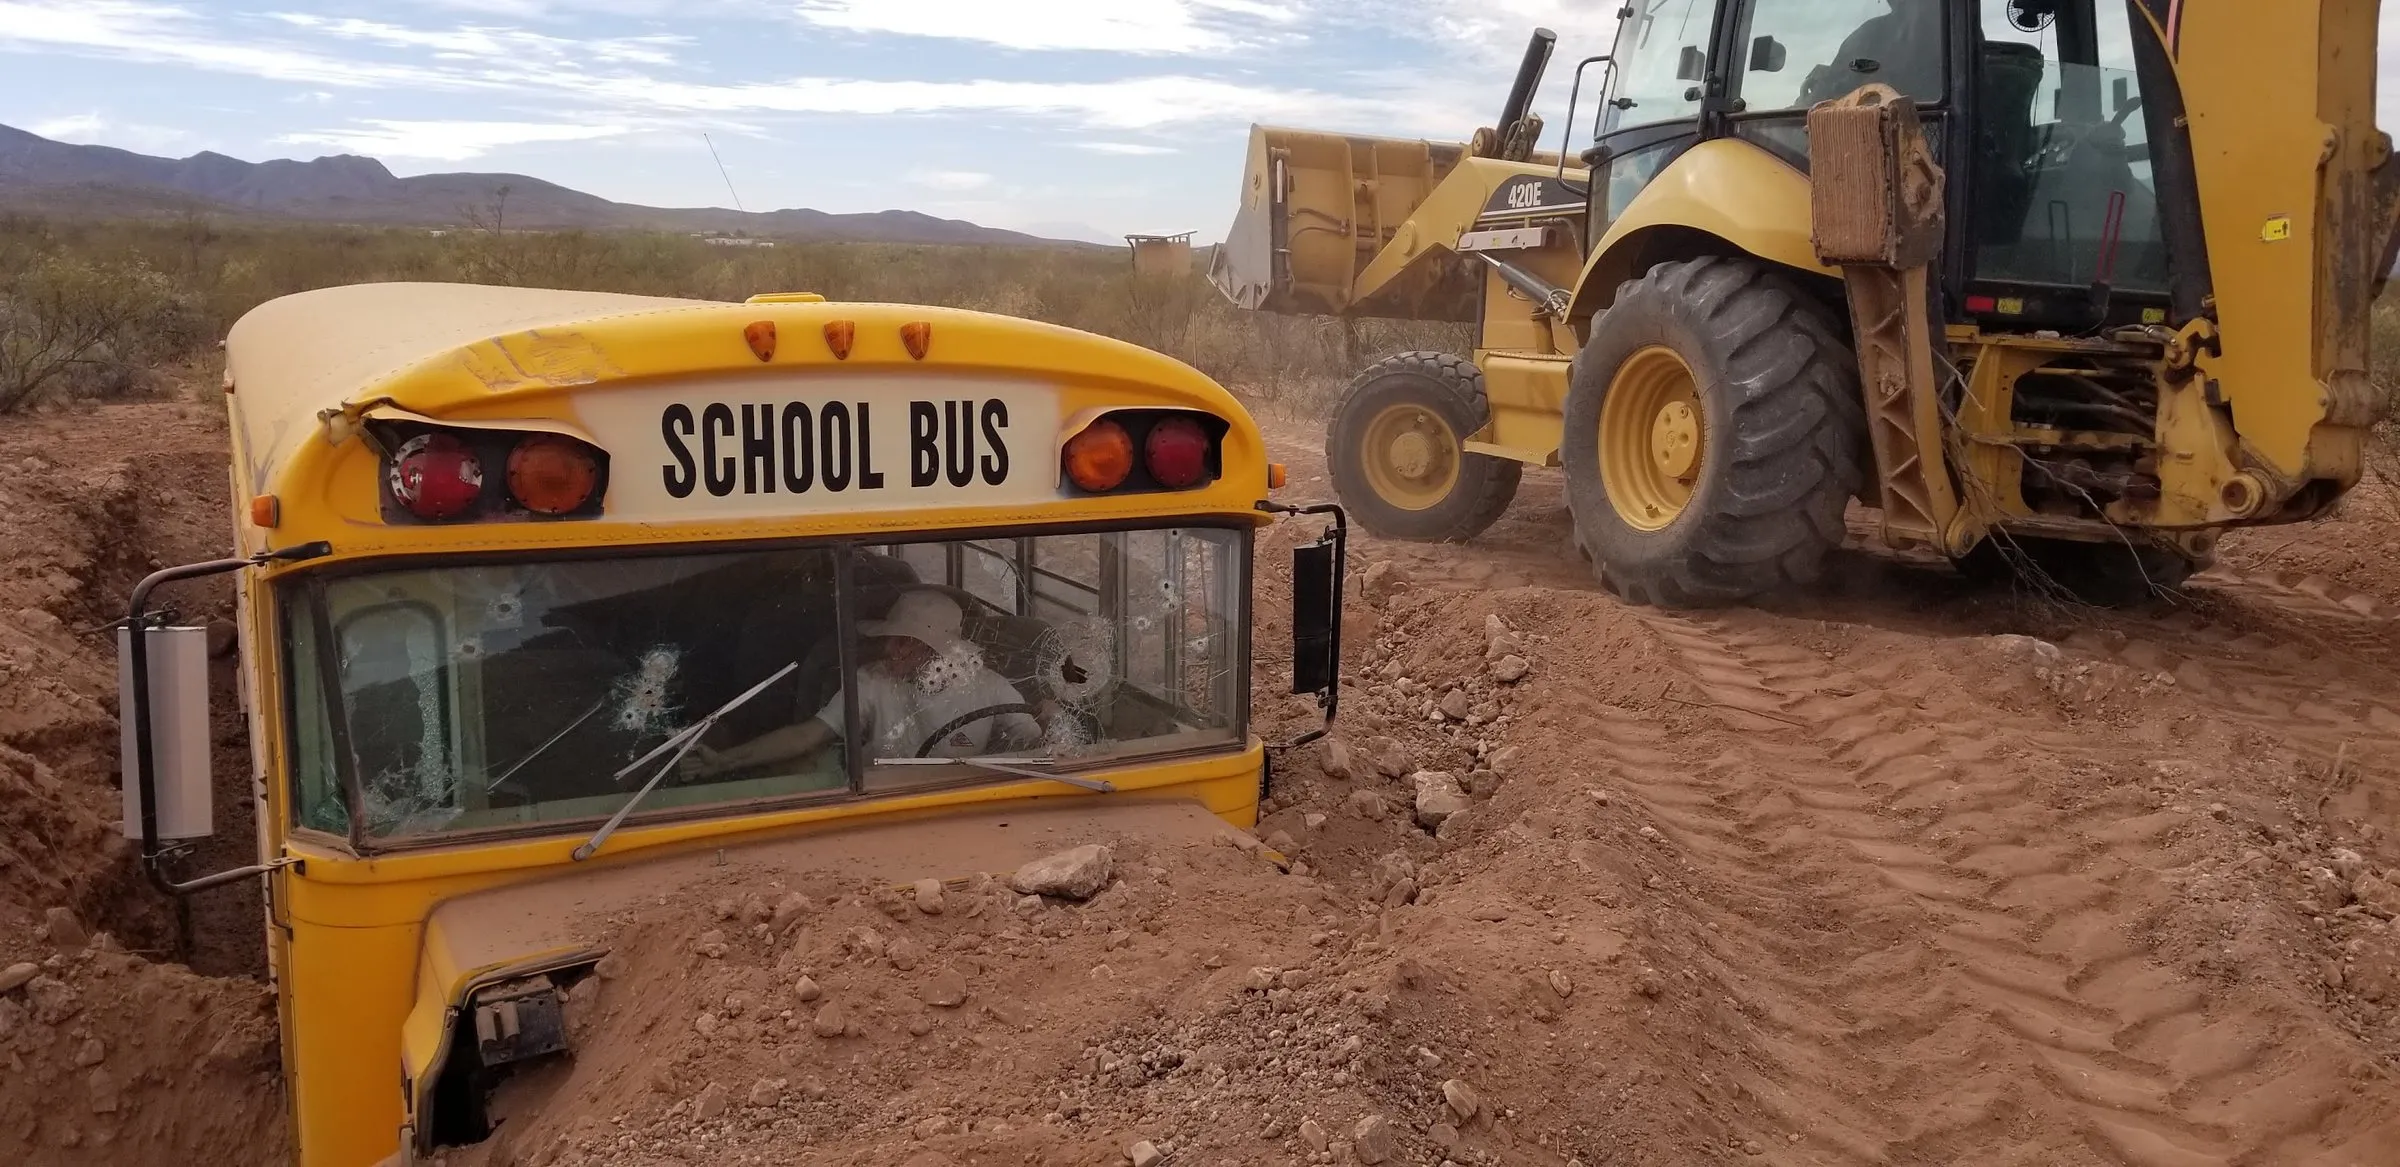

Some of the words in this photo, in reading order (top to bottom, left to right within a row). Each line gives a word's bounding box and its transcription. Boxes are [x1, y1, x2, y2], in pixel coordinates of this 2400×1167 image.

[1508, 181, 1542, 208] 420E
[662, 401, 884, 498] SCHOOL
[910, 398, 1009, 487] BUS
